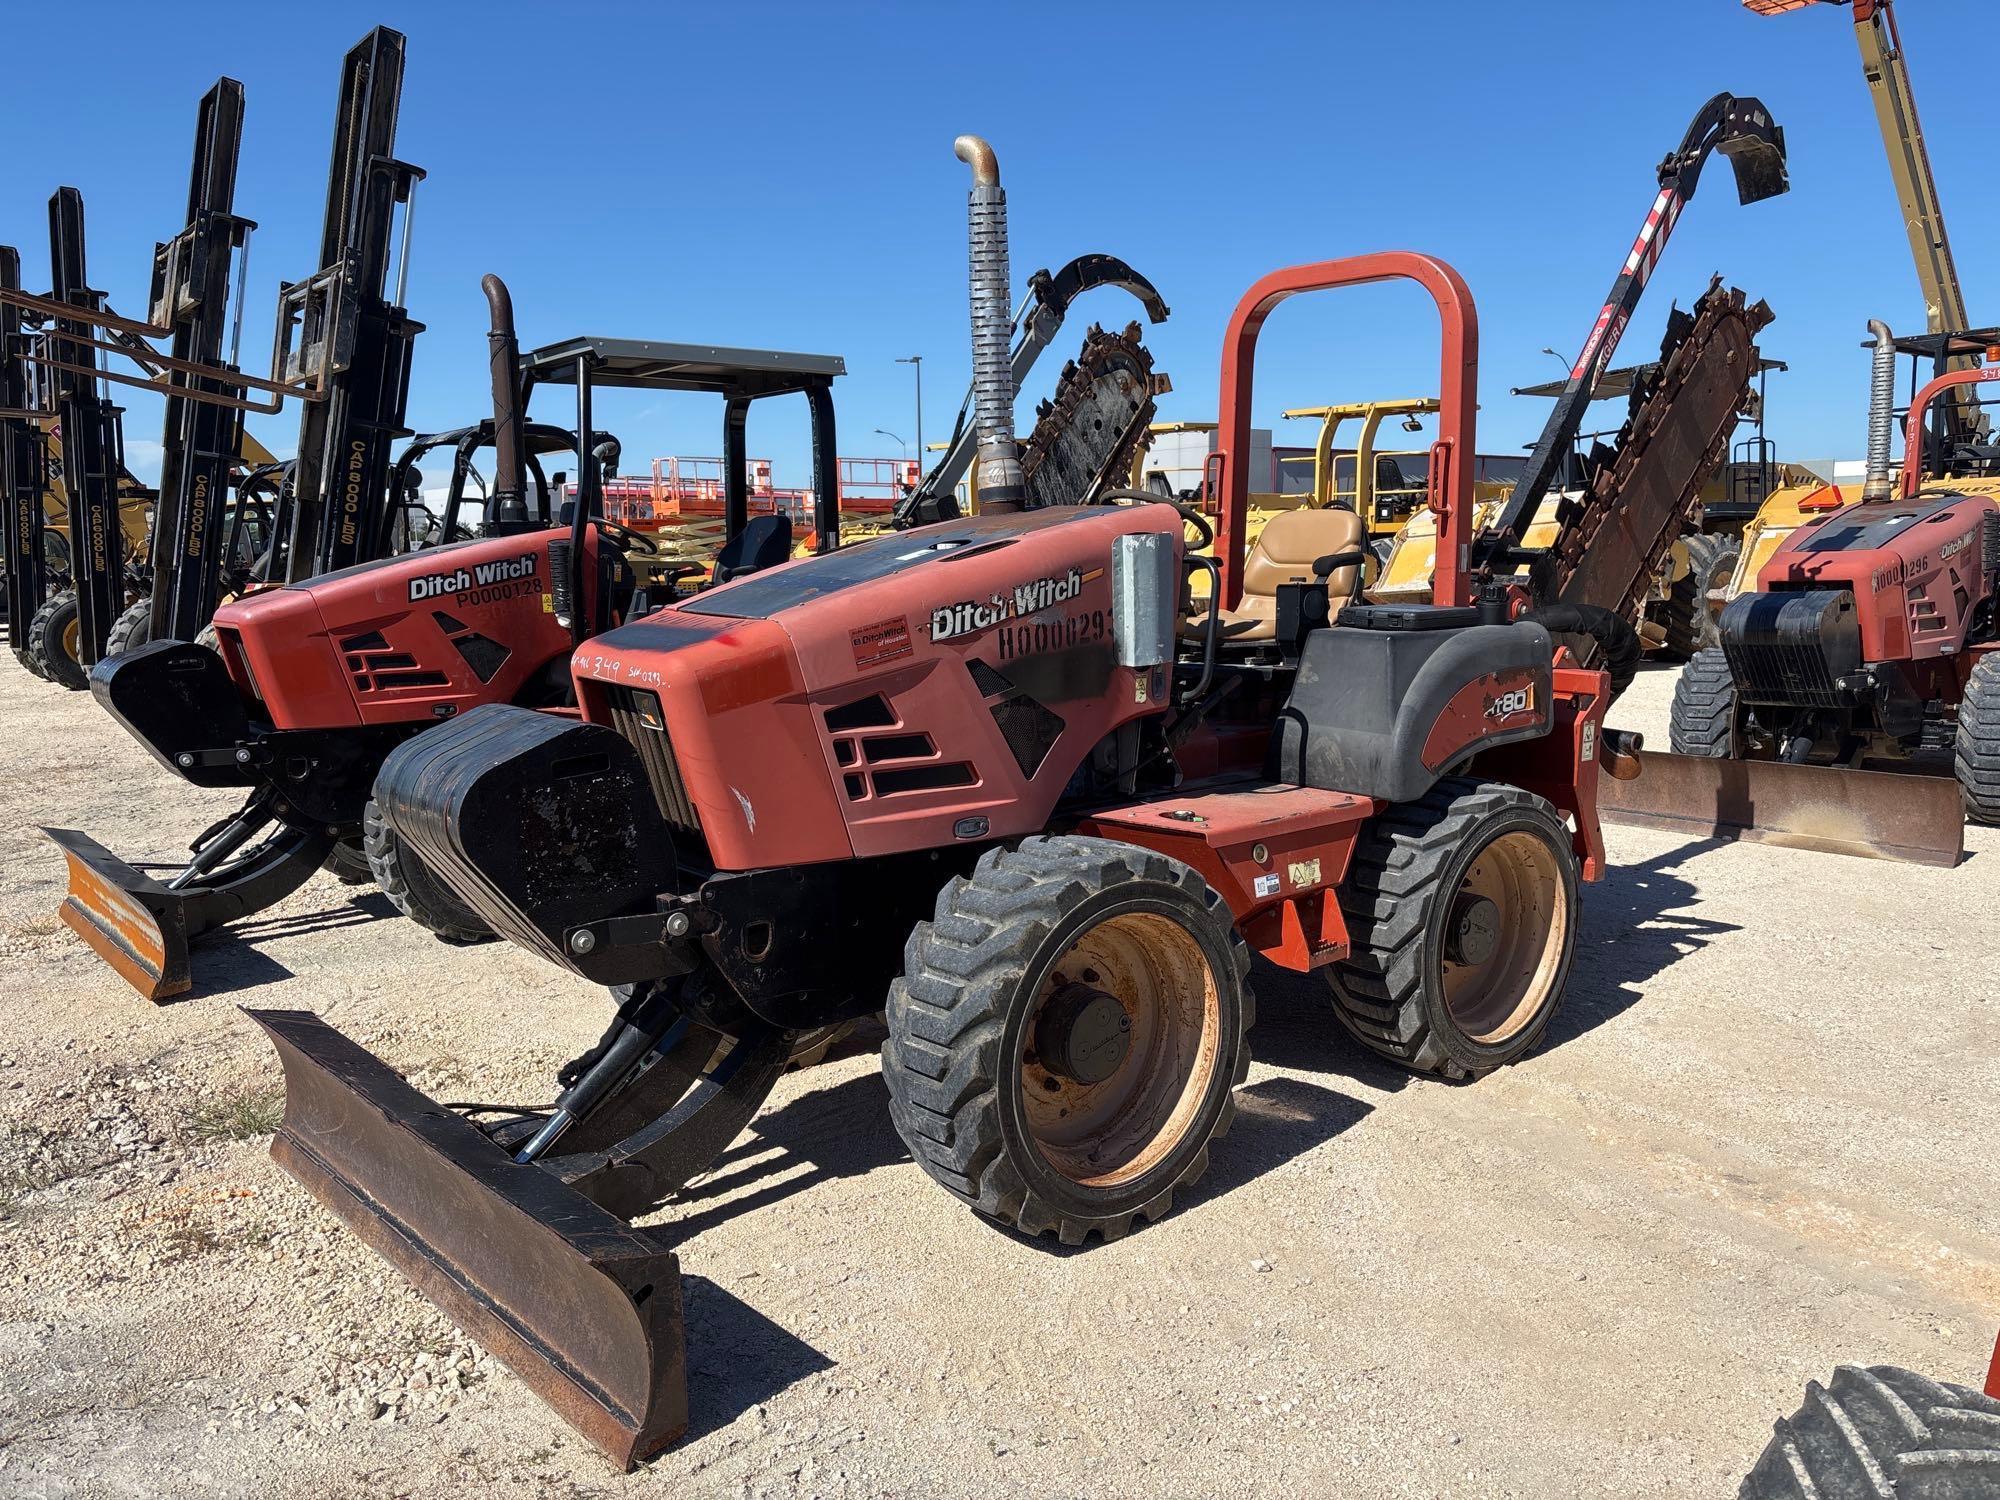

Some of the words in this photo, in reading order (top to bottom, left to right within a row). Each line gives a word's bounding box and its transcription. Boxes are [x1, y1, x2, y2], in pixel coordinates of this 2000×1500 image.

[1578, 327, 1602, 369] DANGER
[350, 441, 366, 470] CAP
[195, 475, 208, 498] CAP
[345, 472, 361, 512] 8000
[19, 499, 28, 515] CAP
[91, 505, 102, 525] CAP
[191, 500, 205, 532] 8000
[188, 532, 200, 556] LBS
[341, 515, 355, 545] LBS
[22, 539, 30, 555] LBS
[96, 552, 105, 572] LBS
[410, 570, 470, 600] Ditch
[475, 556, 534, 585] Witch
[456, 579, 543, 608] P0000128
[1014, 570, 1081, 616] Witch
